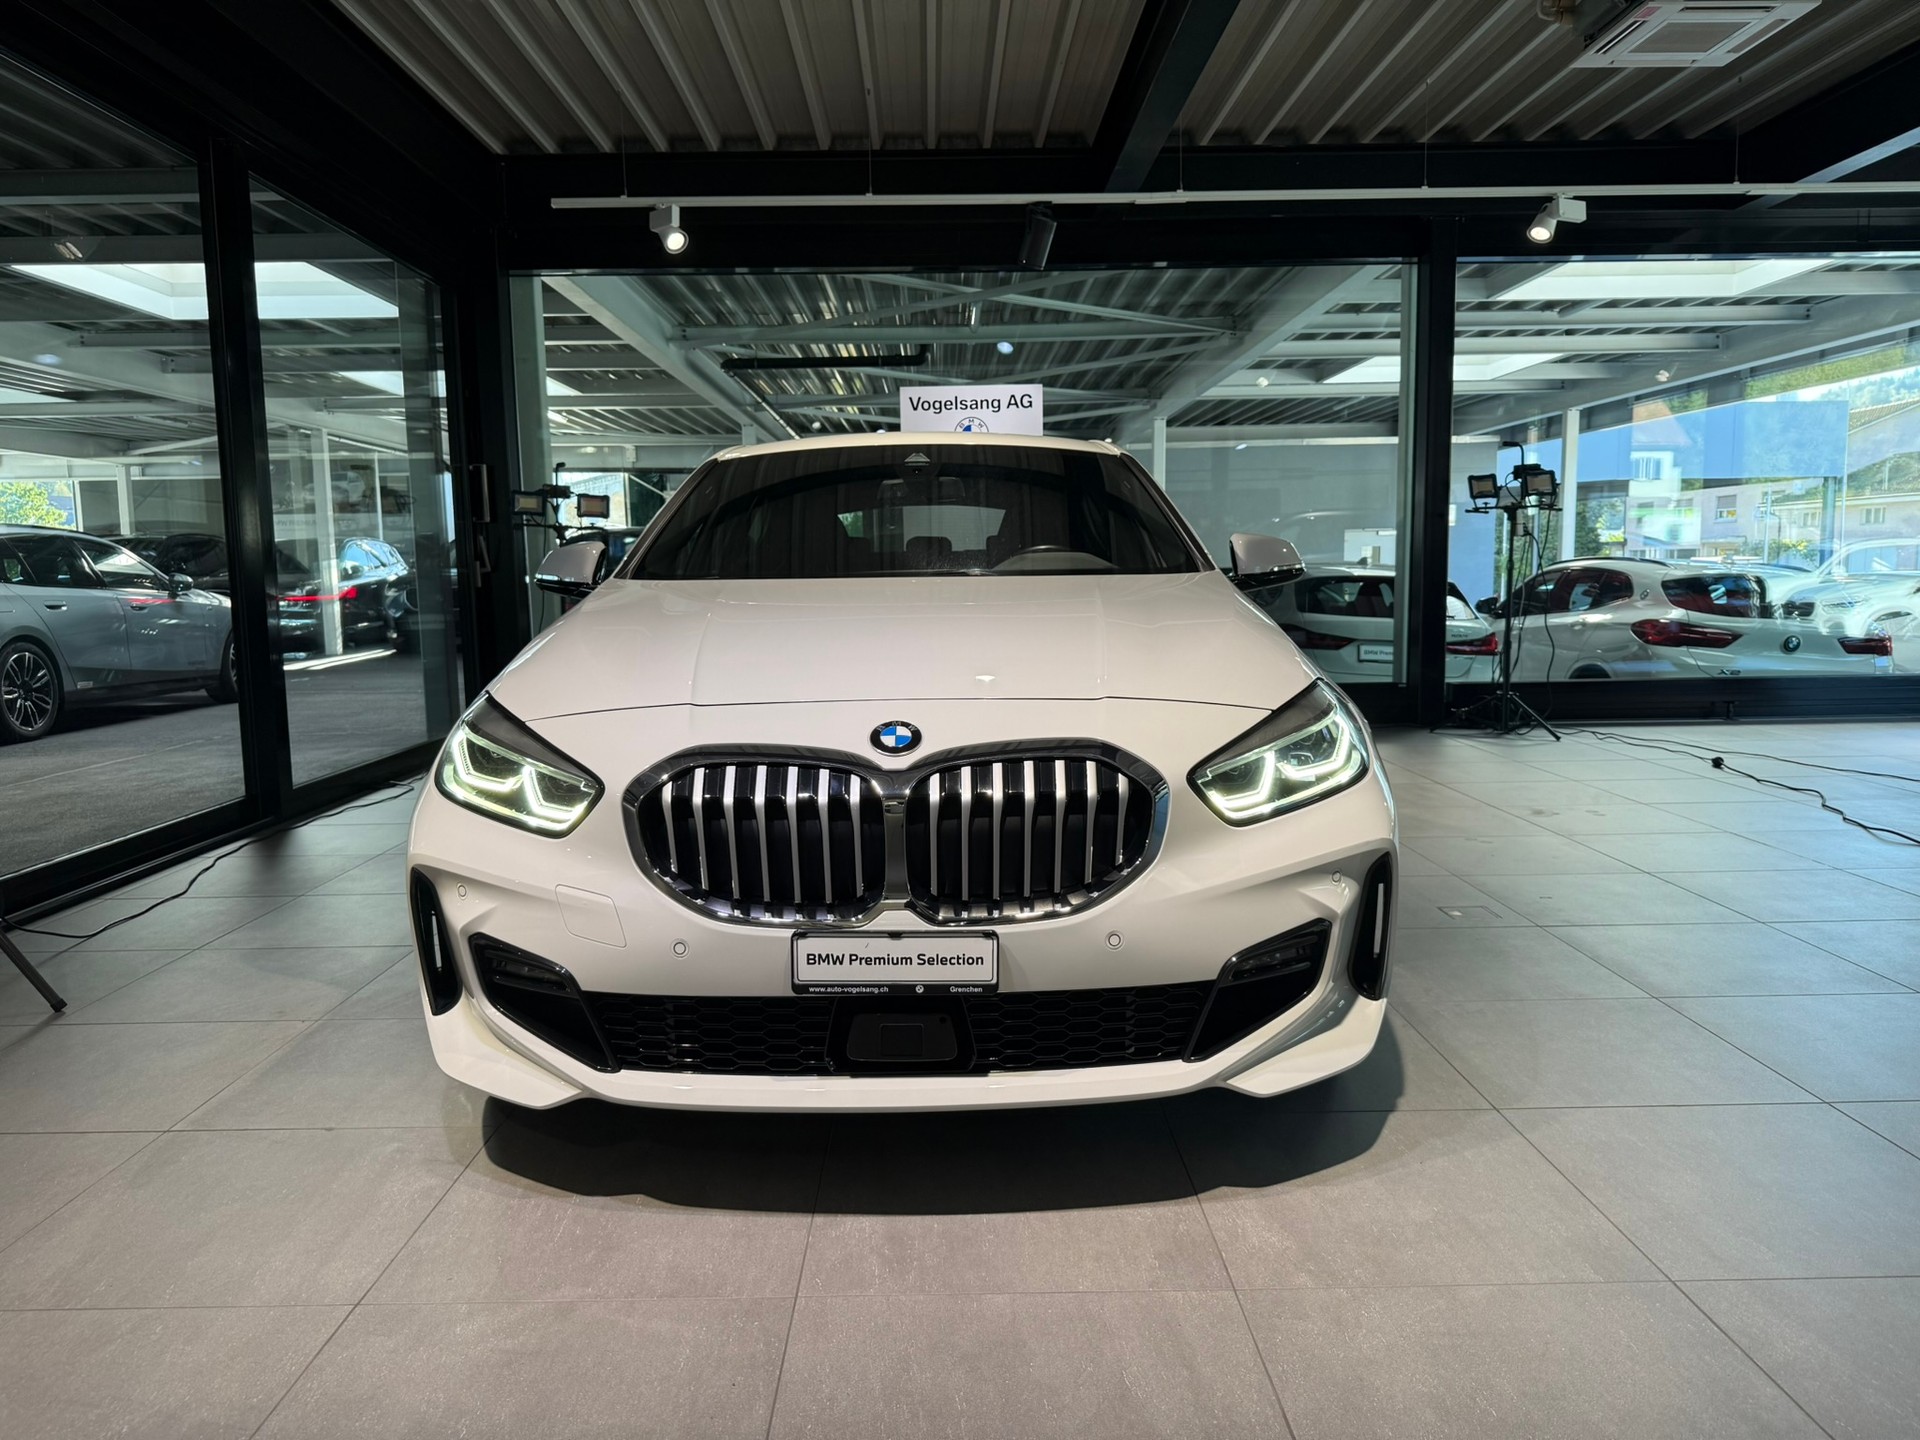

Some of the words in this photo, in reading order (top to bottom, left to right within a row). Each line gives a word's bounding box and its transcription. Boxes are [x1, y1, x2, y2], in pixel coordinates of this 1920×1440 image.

[908, 395, 1001, 415] Vogelsang
[1006, 393, 1033, 409] AG
[958, 418, 985, 429] BMW
[806, 953, 845, 966] BMW
[849, 953, 913, 966] Premium
[916, 953, 984, 966] Selection
[808, 985, 889, 994] www.auto-vogelsang.ch
[949, 985, 983, 993] Grenchen
